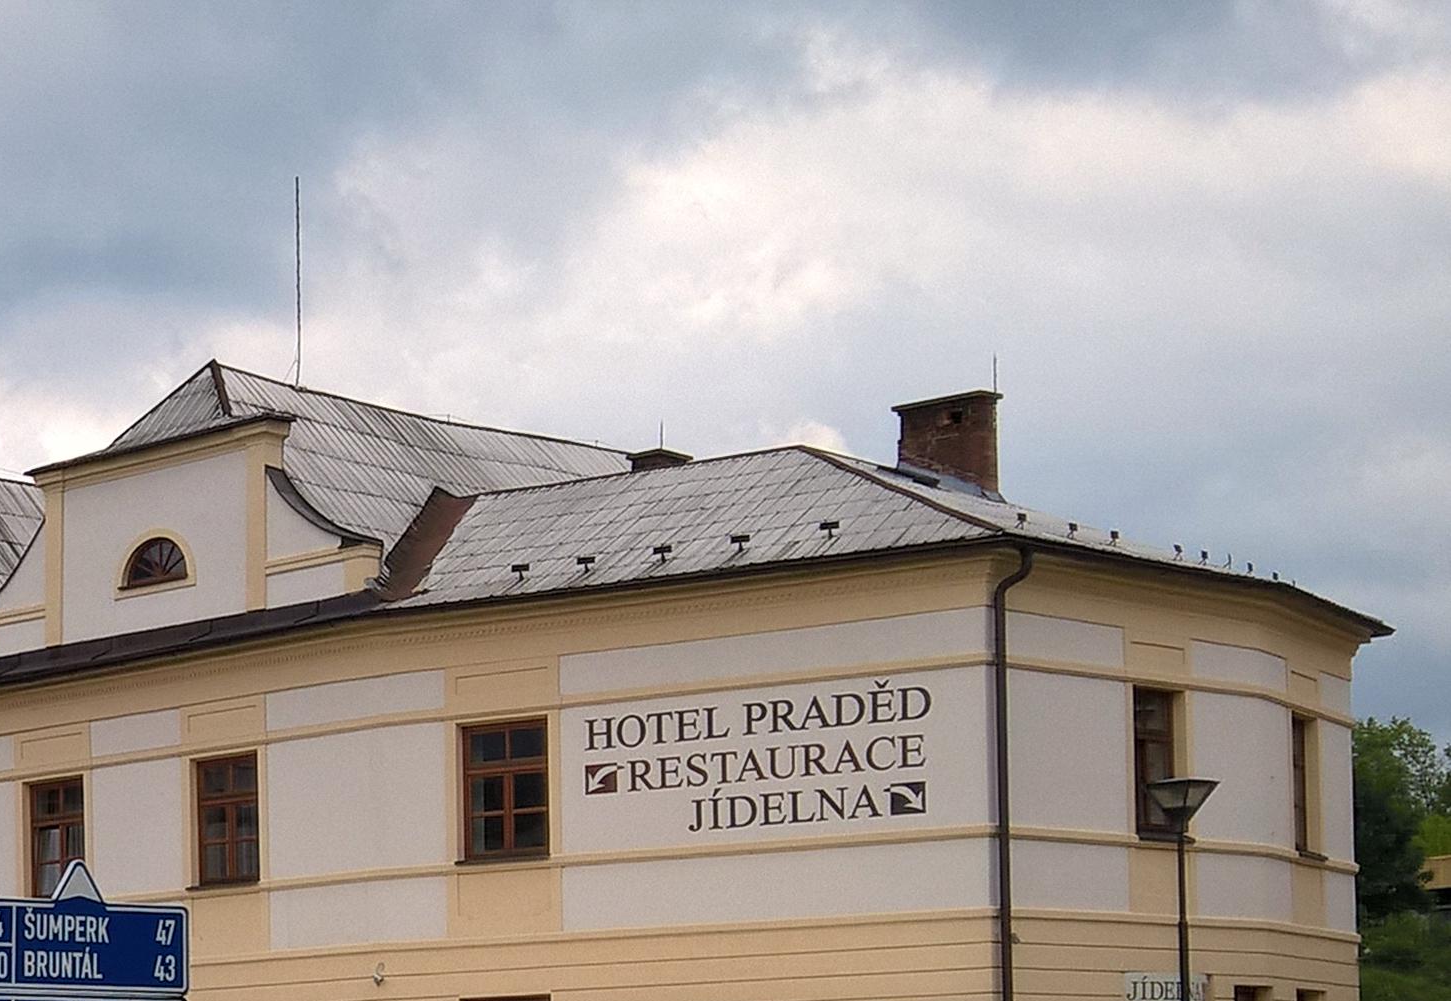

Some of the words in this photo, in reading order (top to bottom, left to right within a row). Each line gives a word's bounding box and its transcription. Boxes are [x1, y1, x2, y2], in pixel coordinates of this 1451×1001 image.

[583, 706, 731, 751] HOTEL
[742, 679, 932, 737] PRADĚD
[627, 734, 927, 793] RESTAURACE
[688, 784, 883, 832] JÍDELNA
[24, 907, 110, 944] ŠUMPERK
[155, 919, 176, 946] 47
[23, 947, 103, 980] BRUNTÁL
[154, 955, 176, 982] 43
